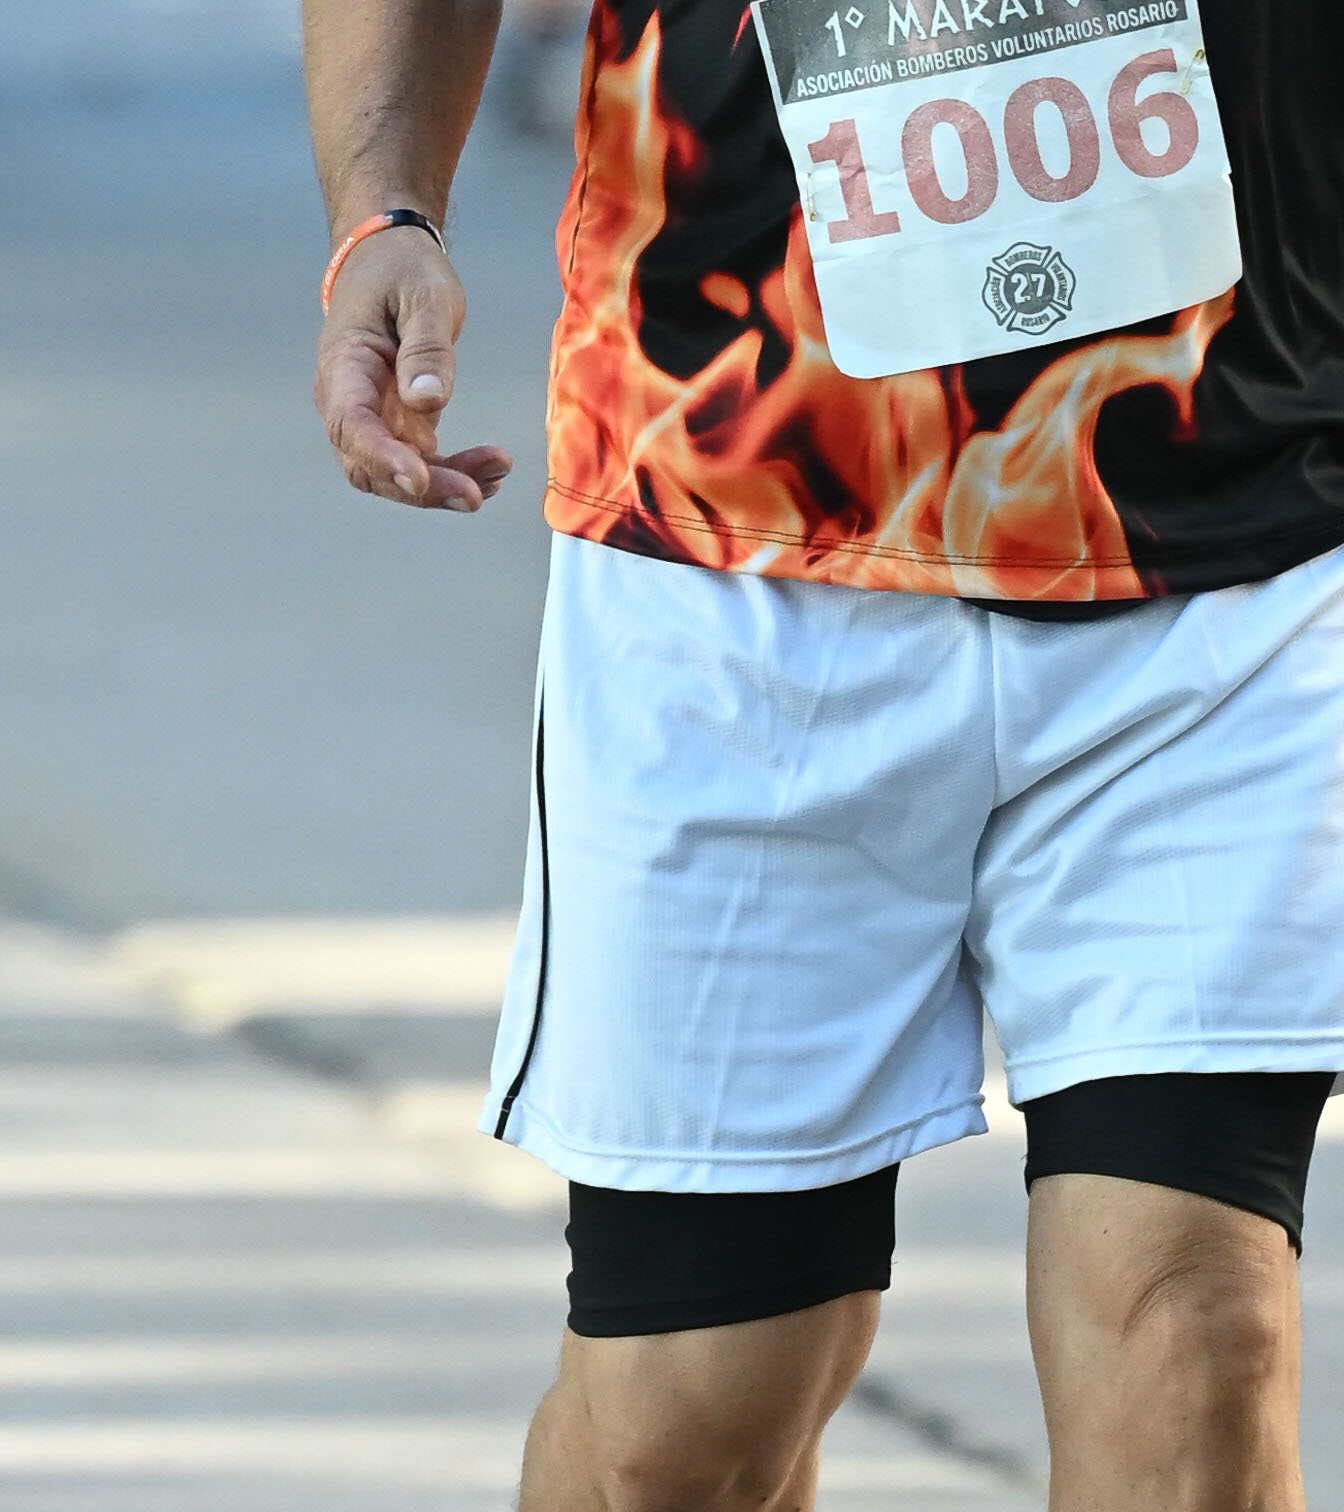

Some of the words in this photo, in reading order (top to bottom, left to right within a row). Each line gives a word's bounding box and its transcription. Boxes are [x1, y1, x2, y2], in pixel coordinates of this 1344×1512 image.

[796, 59, 893, 98] ASOCIACIÓN
[896, 43, 988, 78] BOMBEROS
[991, 16, 1104, 58] VOLUNTARIOS
[1107, 0, 1178, 32] ROSARIO
[807, 47, 1199, 244] 1006
[1010, 272, 1046, 304] 27
